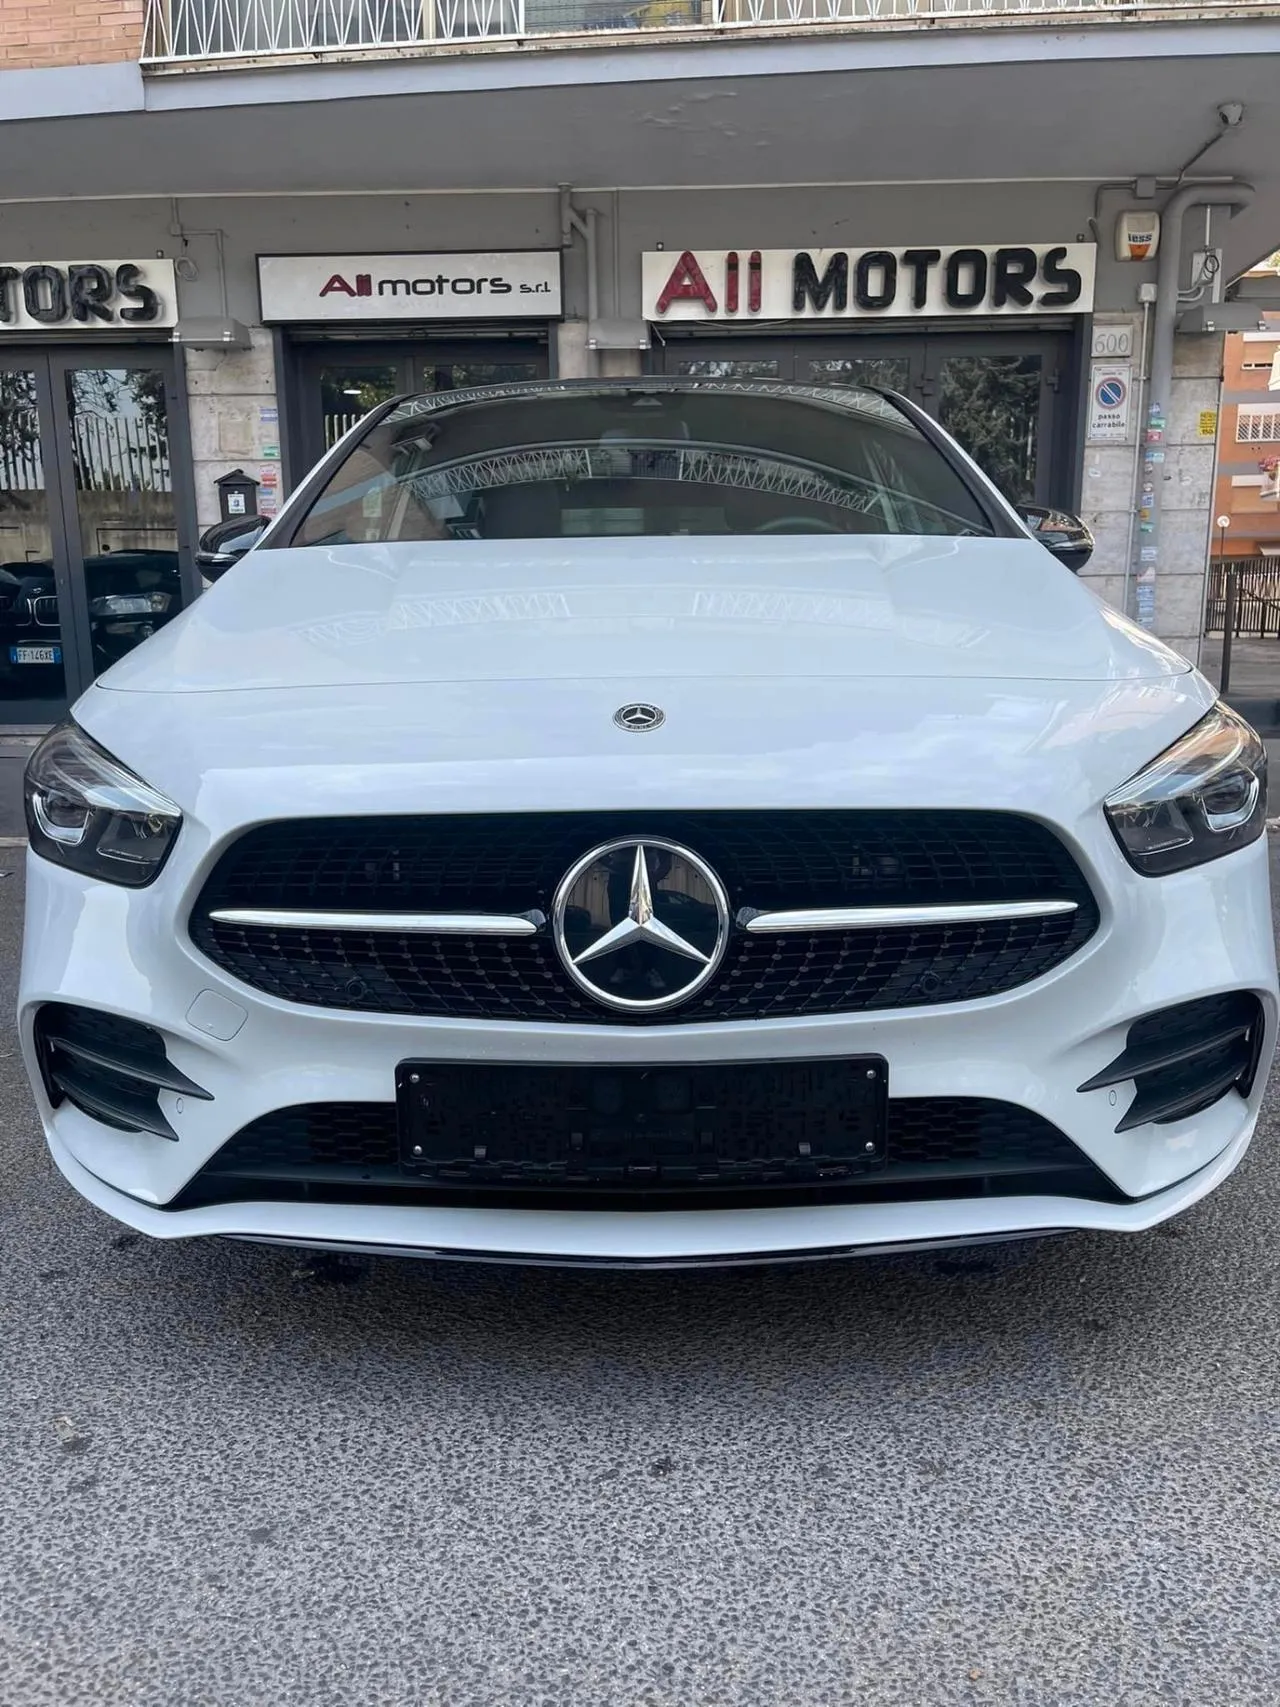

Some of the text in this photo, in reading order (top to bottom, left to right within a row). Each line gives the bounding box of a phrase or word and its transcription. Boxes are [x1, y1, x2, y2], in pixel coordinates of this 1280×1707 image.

[319, 274, 373, 297] All
[378, 274, 512, 296] motors
[655, 246, 1082, 315] All MOTORS
[1094, 332, 1129, 353] 600
